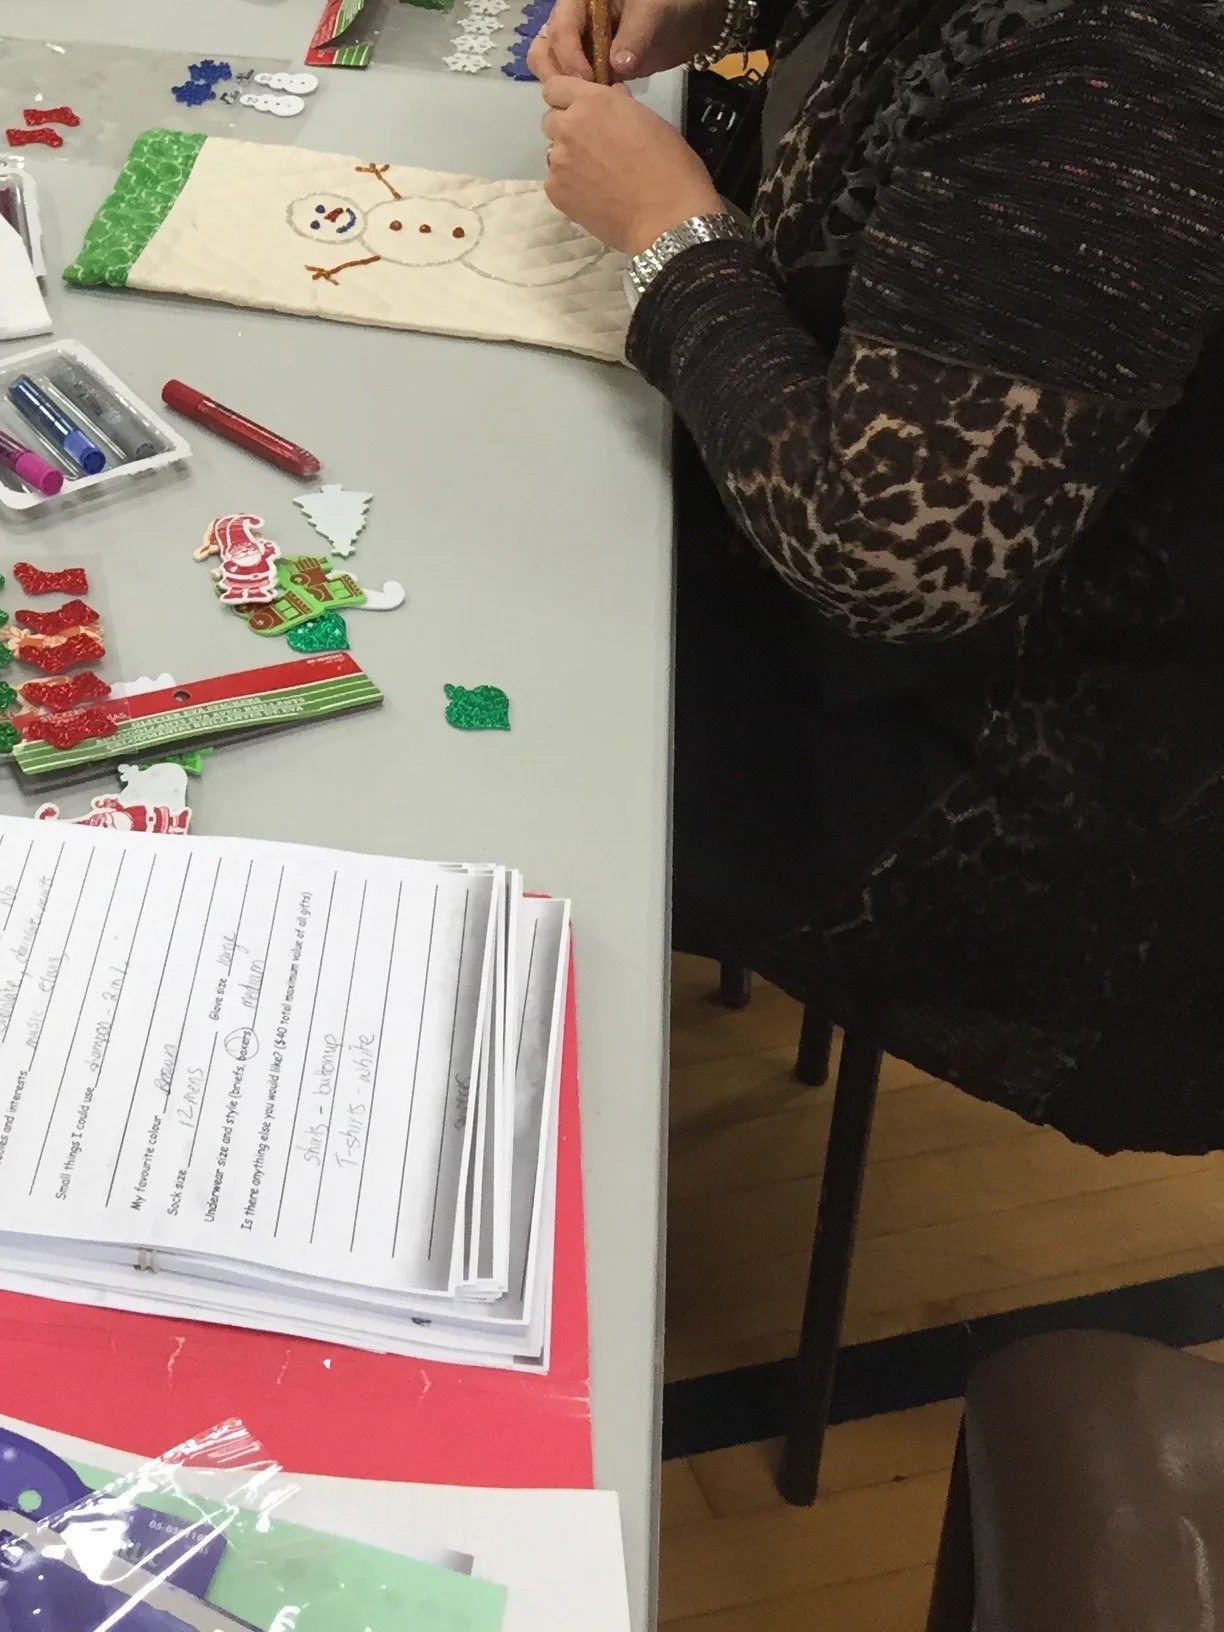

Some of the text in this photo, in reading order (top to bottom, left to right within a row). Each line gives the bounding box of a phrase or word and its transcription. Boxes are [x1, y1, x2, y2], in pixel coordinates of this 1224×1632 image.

[207, 978, 228, 1021] Glove size
[239, 891, 313, 1230] Is there anything else you would like? ($40 total maximum value of all gifts)
[6, 1069, 29, 1113] interests
[82, 1086, 96, 1102] use
[2, 1114, 15, 1132] and
[75, 1103, 90, 1131] could
[224, 1100, 239, 1124] style
[221, 1125, 233, 1144] and
[62, 1140, 82, 1170] things
[129, 1114, 162, 1211] My favourite colour
[215, 1145, 229, 1166] size
[54, 1172, 71, 1199] Small
[166, 1169, 187, 1216] Sock size
[203, 1168, 224, 1222] Underwear
